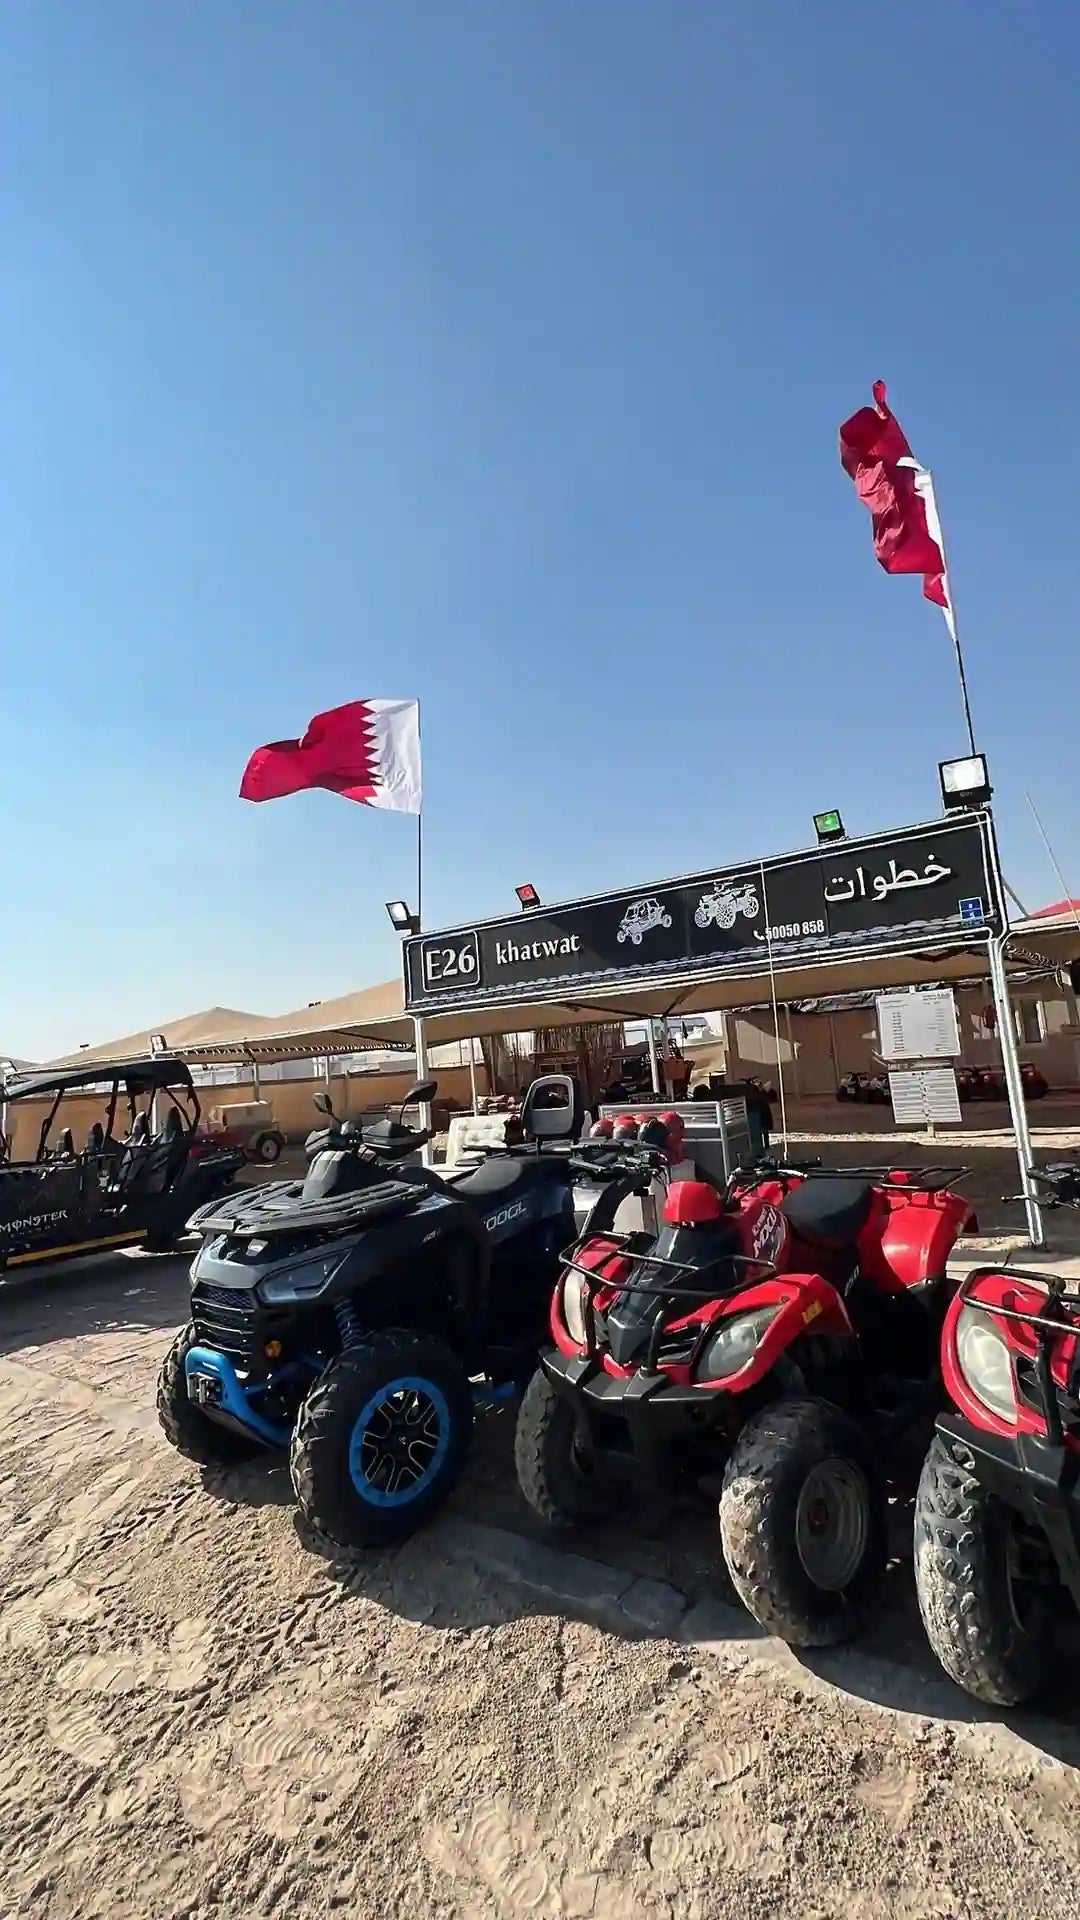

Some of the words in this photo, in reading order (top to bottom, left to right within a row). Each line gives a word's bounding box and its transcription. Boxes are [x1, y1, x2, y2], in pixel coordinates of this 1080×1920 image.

[824, 854, 951, 902] خطوات
[765, 923, 800, 940] 50050
[802, 920, 825, 935] 858
[426, 944, 475, 981] E26
[495, 934, 580, 965] khatwat
